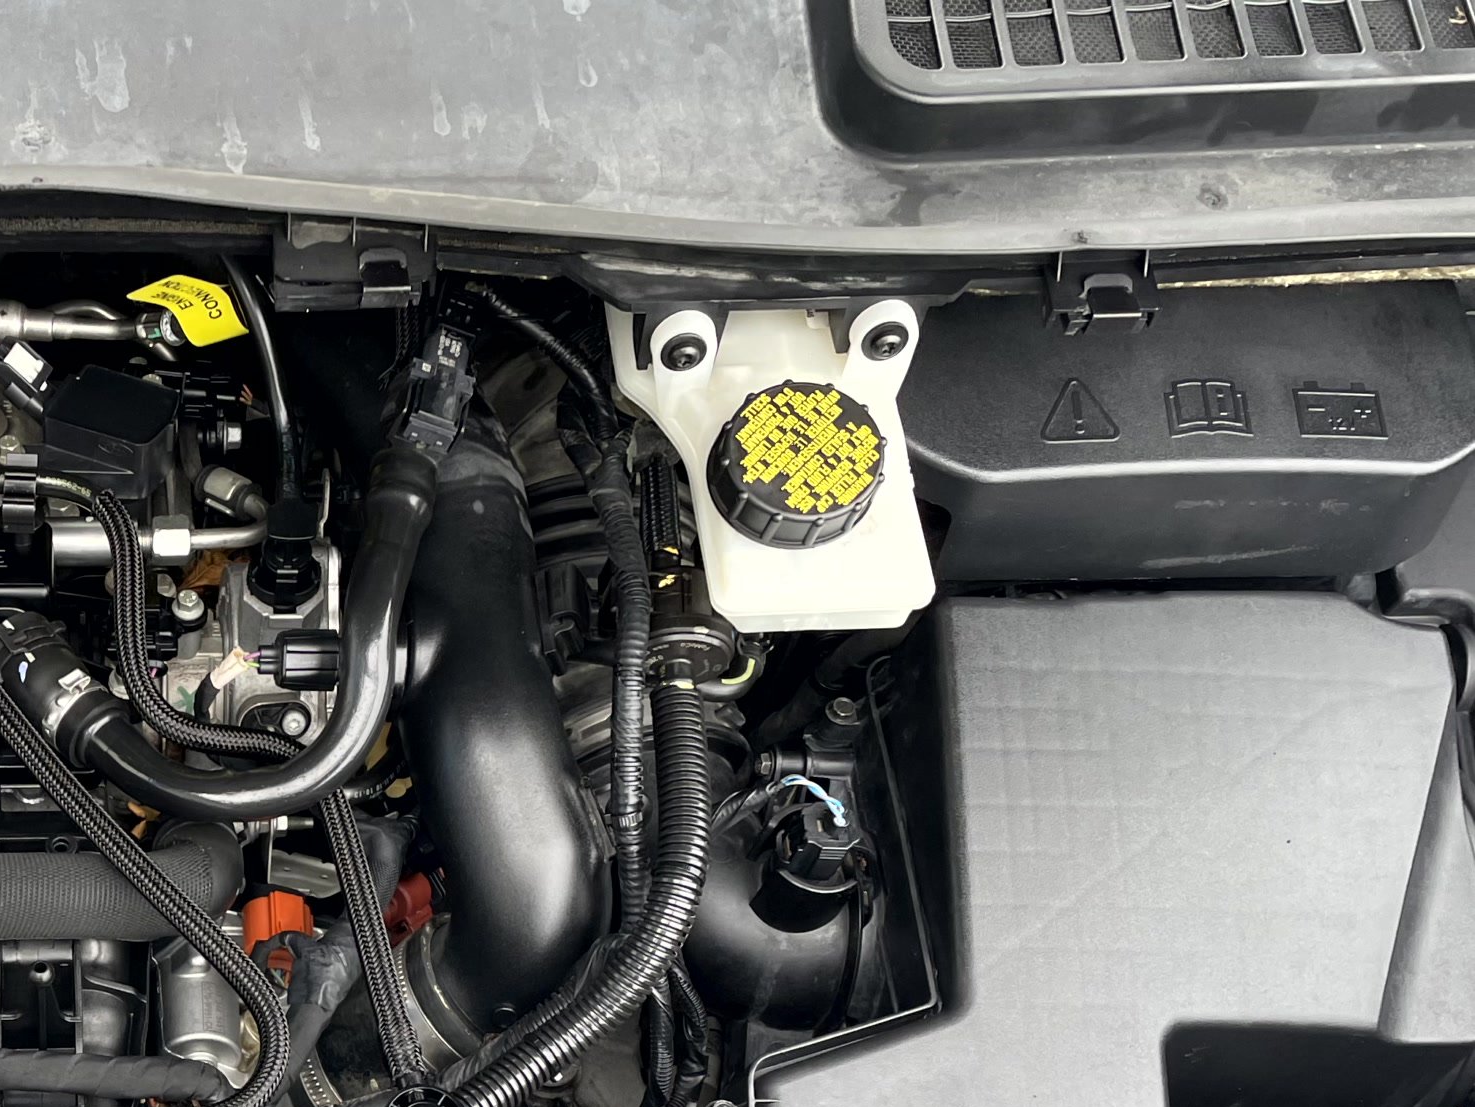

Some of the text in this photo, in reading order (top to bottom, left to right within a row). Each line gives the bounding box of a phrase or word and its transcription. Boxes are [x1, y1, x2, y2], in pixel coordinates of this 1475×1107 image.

[772, 386, 794, 407] D'UN
[787, 391, 806, 409] DOT
[793, 389, 824, 417] PLOYER
[813, 389, 840, 414] AVANT
[779, 405, 790, 415] 4
[803, 408, 819, 424] DE
[778, 414, 798, 432] QUE
[792, 420, 808, 434] LE
[846, 421, 857, 431] A
[767, 427, 784, 443] DU
[793, 436, 808, 451] LE
[820, 428, 850, 457] SEALED
[847, 432, 879, 463] BEFORE
[786, 424, 872, 509] ONLY DOT 4 FLUID FROM
[815, 448, 880, 512] CLEAN FILLER CAP
[795, 494, 817, 513] USE
